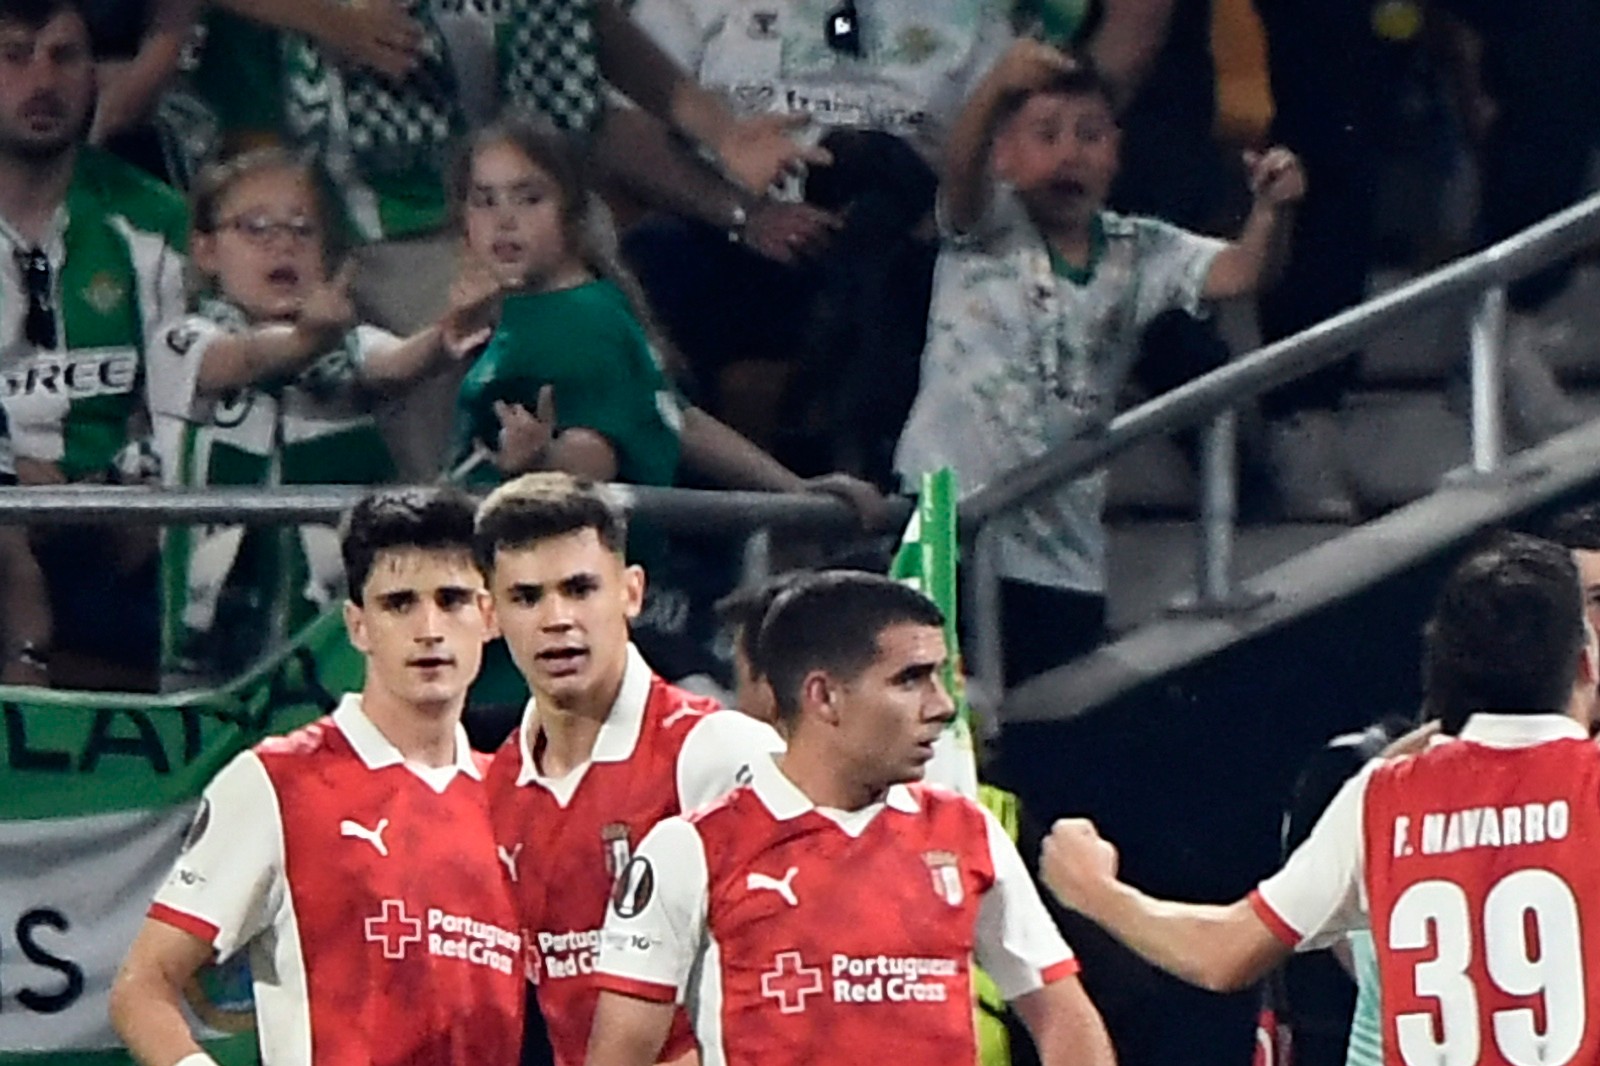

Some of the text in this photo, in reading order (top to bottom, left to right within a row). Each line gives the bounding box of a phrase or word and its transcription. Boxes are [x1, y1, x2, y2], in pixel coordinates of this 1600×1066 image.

[1393, 799, 1569, 858] F. NAVARRO
[833, 978, 882, 1002] Red
